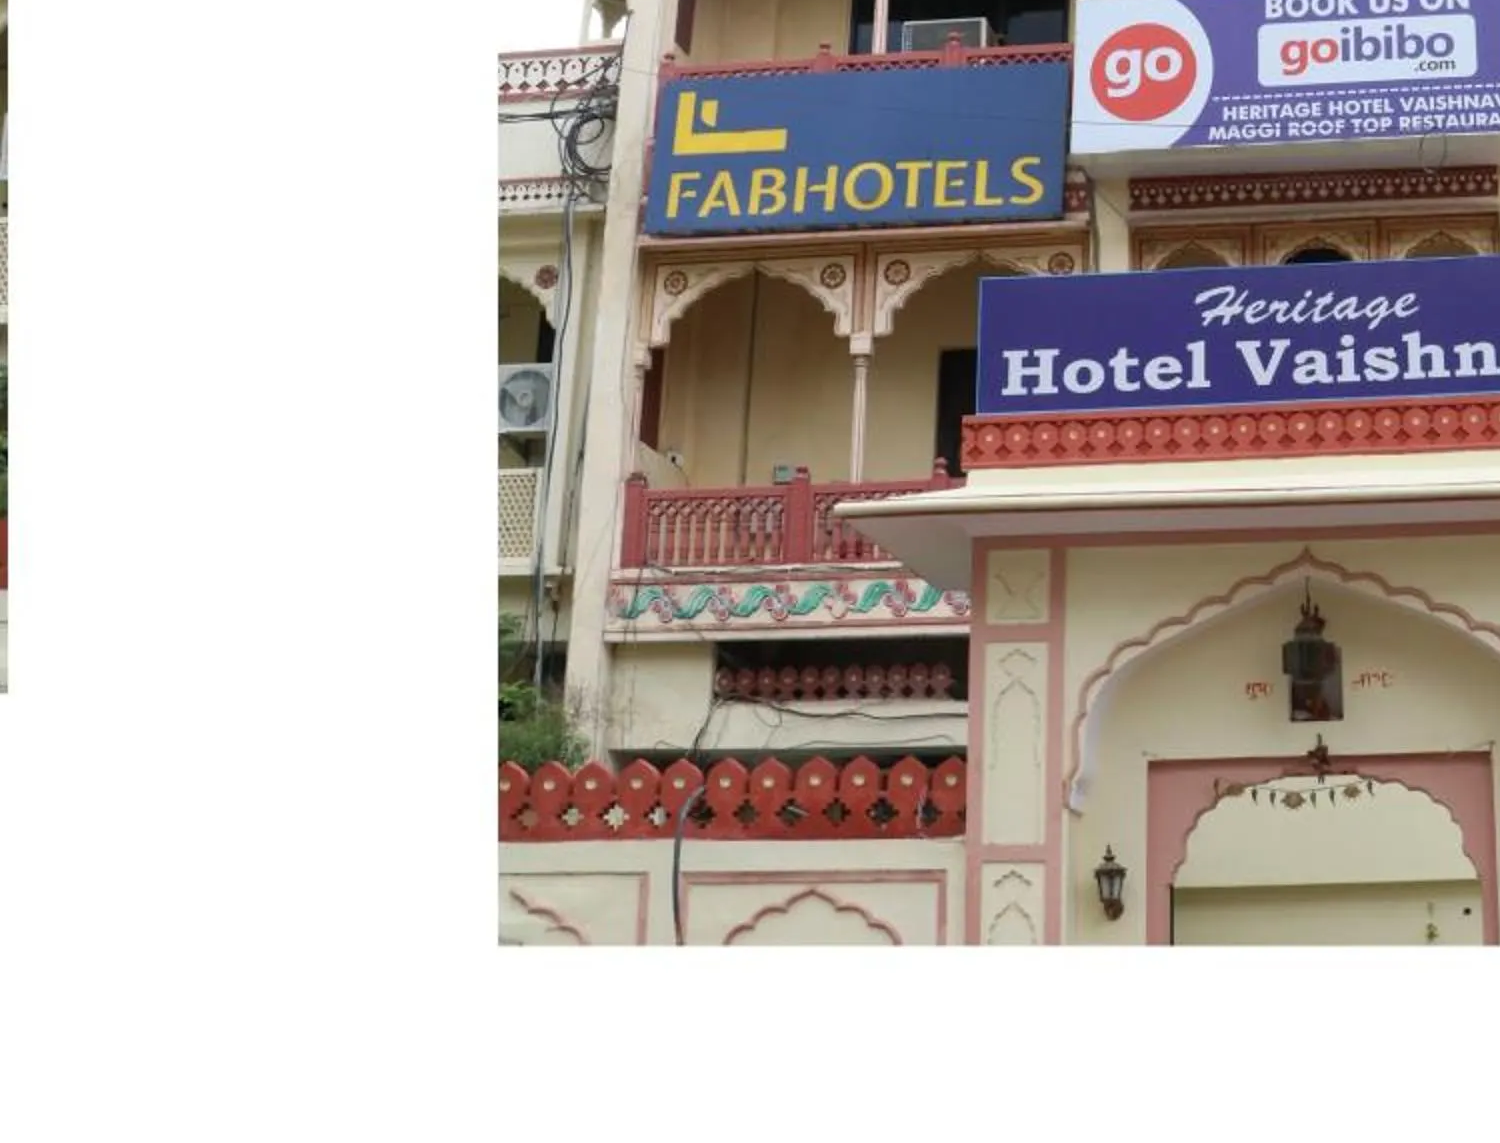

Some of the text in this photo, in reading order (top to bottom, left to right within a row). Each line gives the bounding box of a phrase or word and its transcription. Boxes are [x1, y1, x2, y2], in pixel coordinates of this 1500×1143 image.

[1103, 45, 1183, 98] go
[1279, 22, 1455, 76] goibibo
[1413, 58, 1457, 72] .com
[1208, 122, 1282, 141] MAGGI
[1287, 118, 1345, 138] ROOF
[1351, 116, 1392, 133] TOP
[1222, 101, 1323, 121] HERITAGE
[1328, 97, 1395, 117] HOTEL
[665, 156, 1045, 218] FABHOTELS
[1195, 285, 1419, 332] Heritage
[1001, 340, 1211, 397] Hotel
